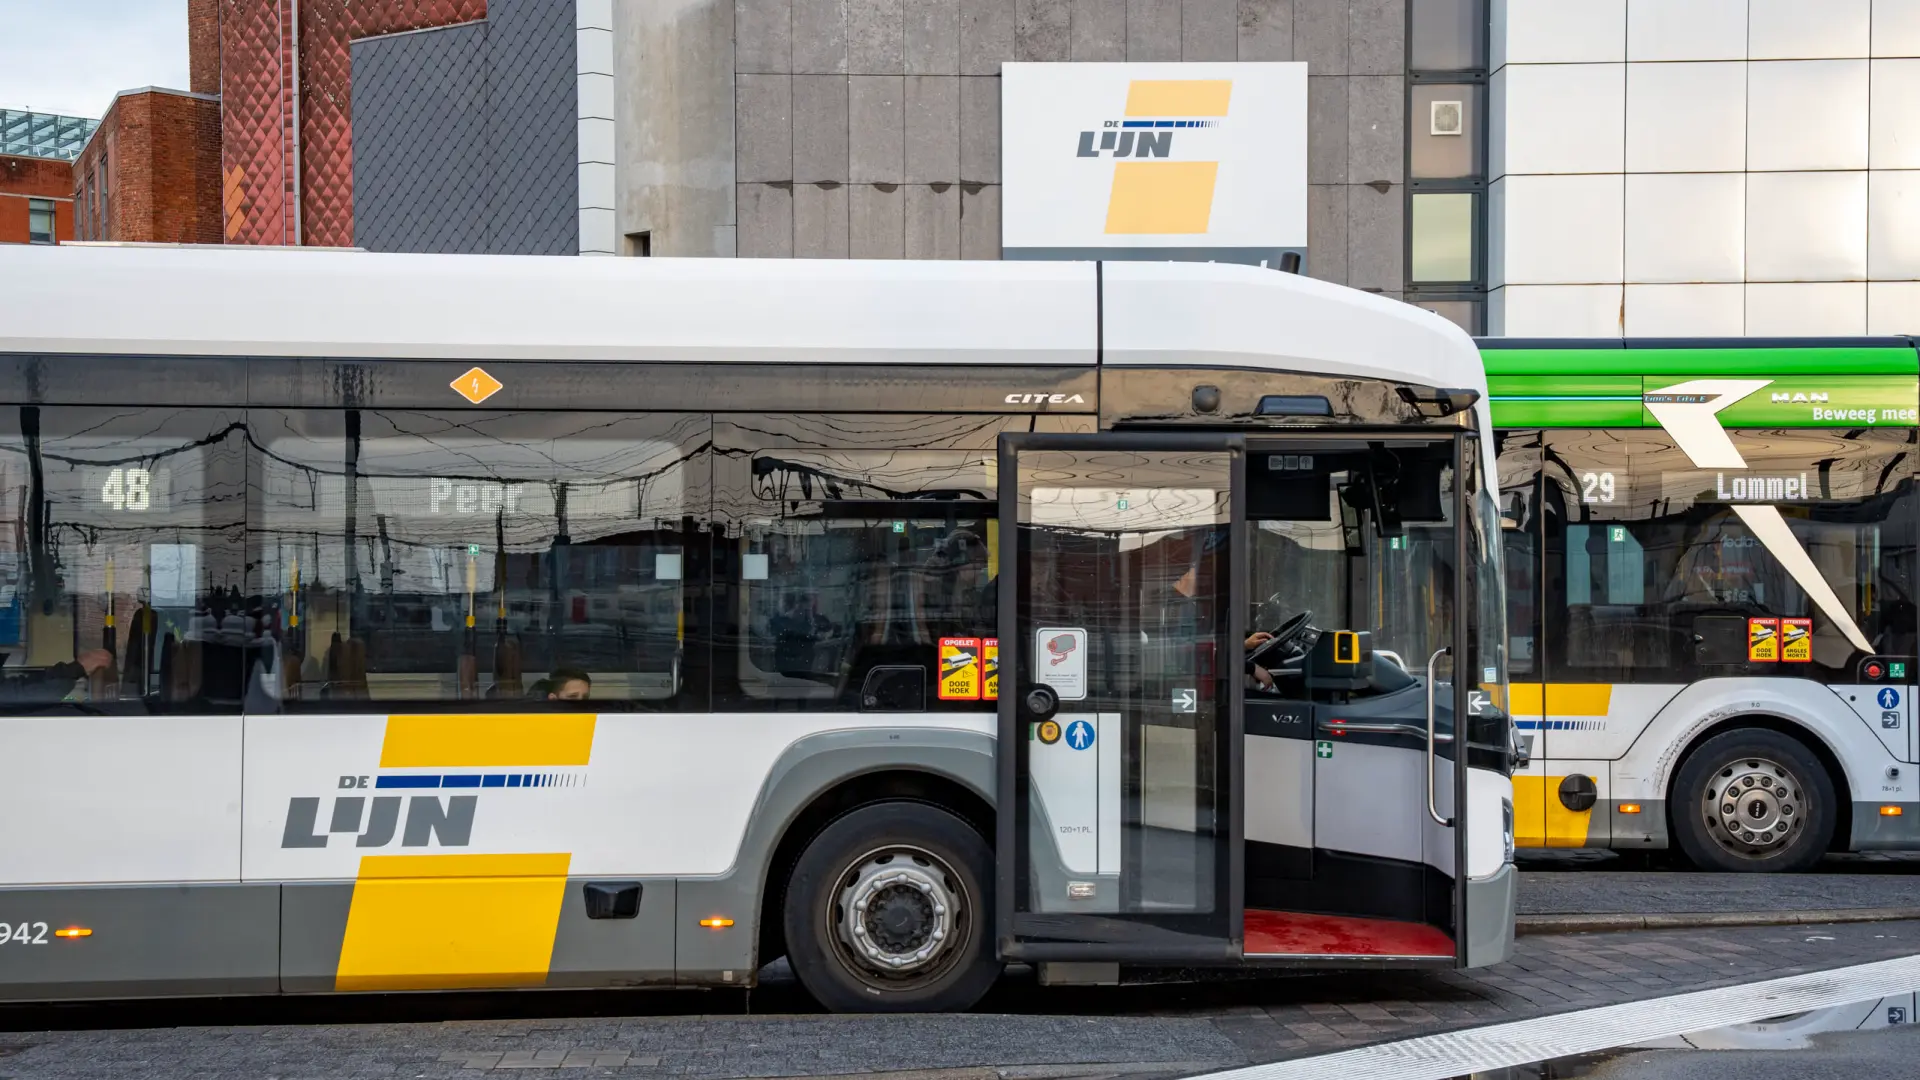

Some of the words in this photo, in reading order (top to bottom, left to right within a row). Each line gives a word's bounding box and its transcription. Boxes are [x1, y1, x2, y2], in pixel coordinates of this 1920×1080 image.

[1104, 120, 1119, 128] DE
[1076, 131, 1173, 157] LIJN
[1004, 393, 1085, 404] CITEA
[1771, 392, 1829, 403] MAN
[1813, 407, 1877, 424] Beweeg
[1882, 408, 1917, 420] mee
[102, 468, 149, 510] 48
[431, 477, 523, 513] Peer
[1583, 472, 1615, 503] 29
[1717, 472, 1809, 500] Lommel
[338, 775, 370, 789] DE
[281, 795, 478, 849] LIJN
[1060, 826, 1081, 834] 120+1
